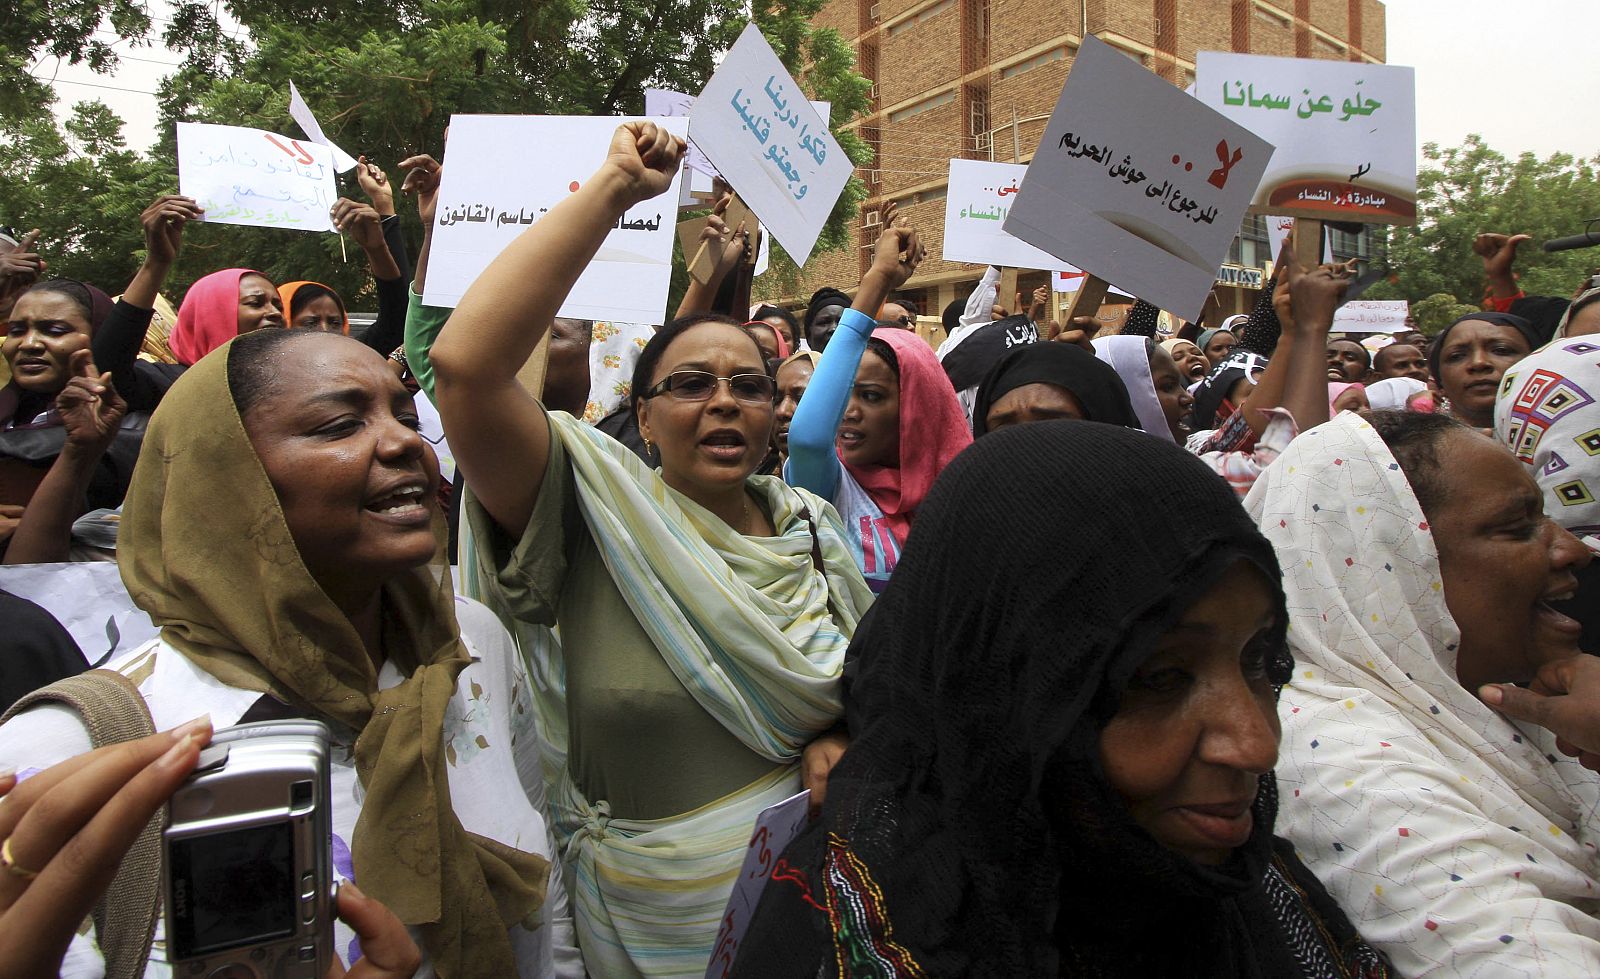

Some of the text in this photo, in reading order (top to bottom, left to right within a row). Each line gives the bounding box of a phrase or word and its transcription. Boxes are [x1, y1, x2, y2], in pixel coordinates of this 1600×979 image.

[764, 75, 799, 129] دربنا
[1223, 80, 1291, 111] سمانا
[1296, 88, 1334, 119] عن
[731, 88, 770, 145] قلبنا
[1058, 132, 1219, 225] للرجوع إلى حوش الحريم
[1207, 138, 1243, 190] لا
[1298, 188, 1331, 201] النساء
[1353, 192, 1386, 208] مبادرة
[439, 203, 494, 227] القانون
[496, 208, 534, 228] باسم
[959, 203, 1009, 221] النساء
